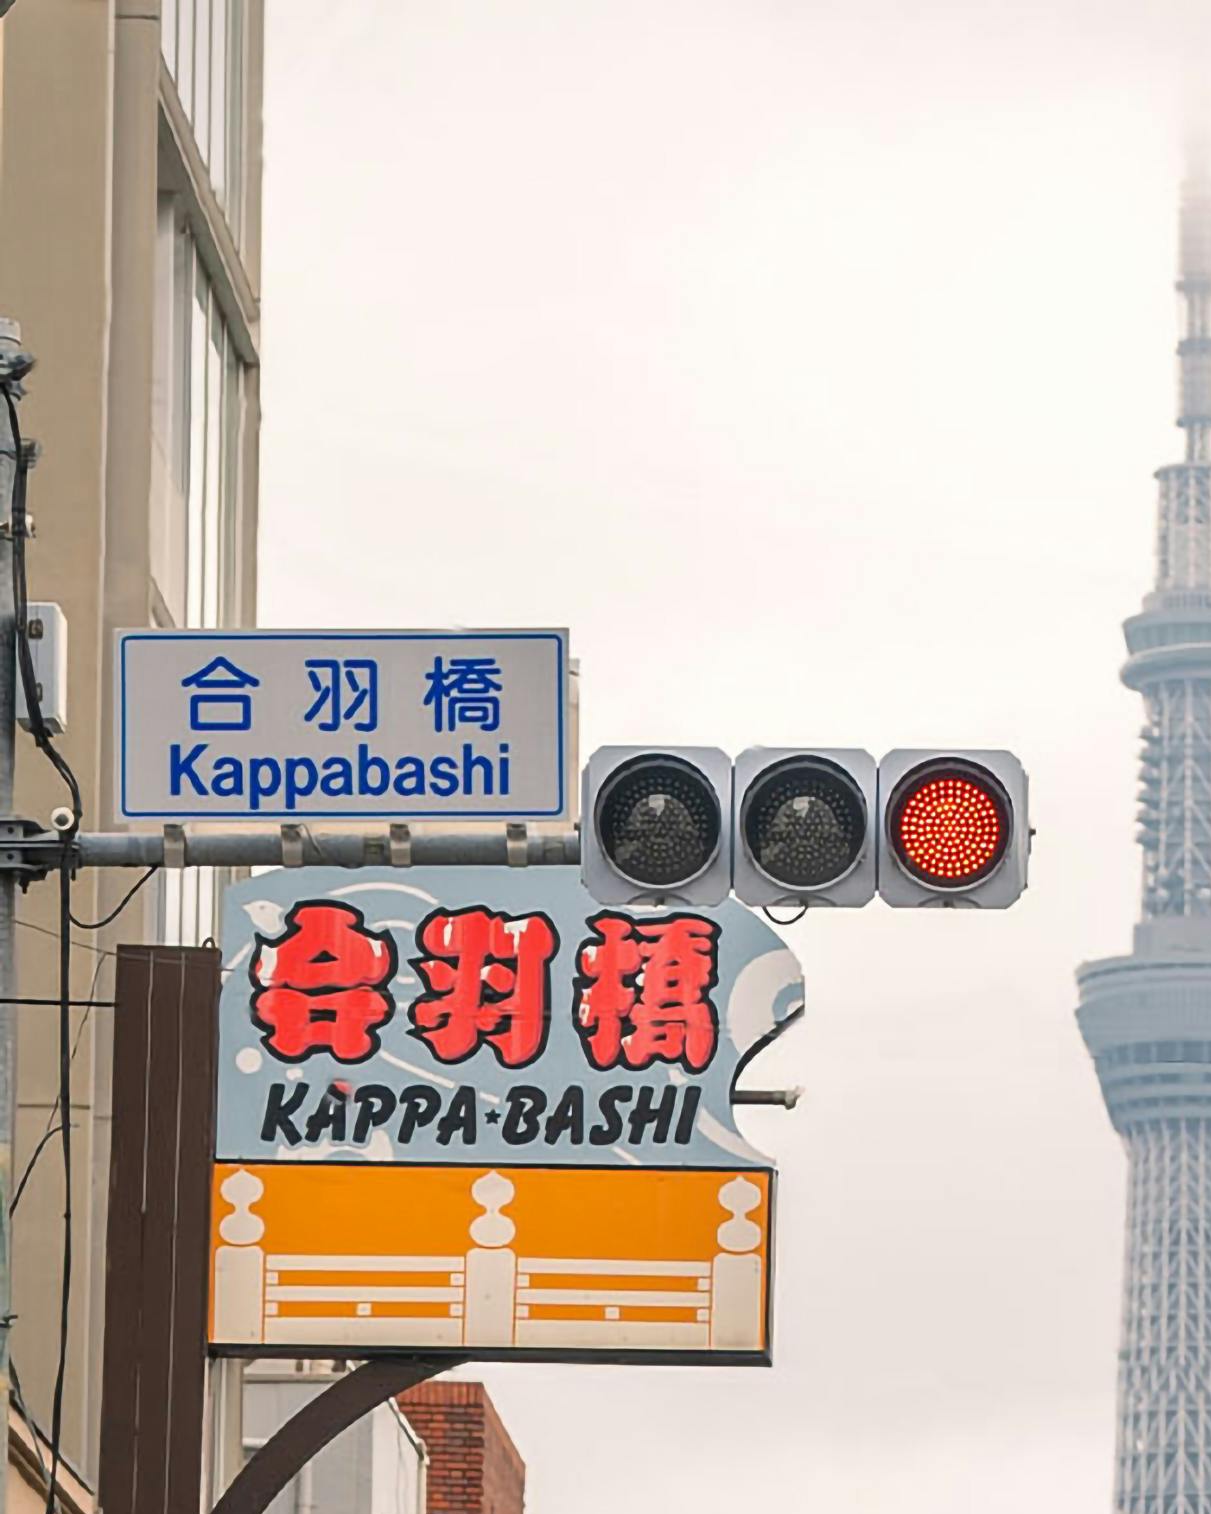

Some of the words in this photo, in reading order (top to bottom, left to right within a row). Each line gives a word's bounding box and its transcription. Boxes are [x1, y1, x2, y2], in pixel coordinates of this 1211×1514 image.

[181, 656, 503, 733] 合羽橋
[169, 743, 511, 809] Kappabashi
[250, 898, 723, 1075] 合羽橋
